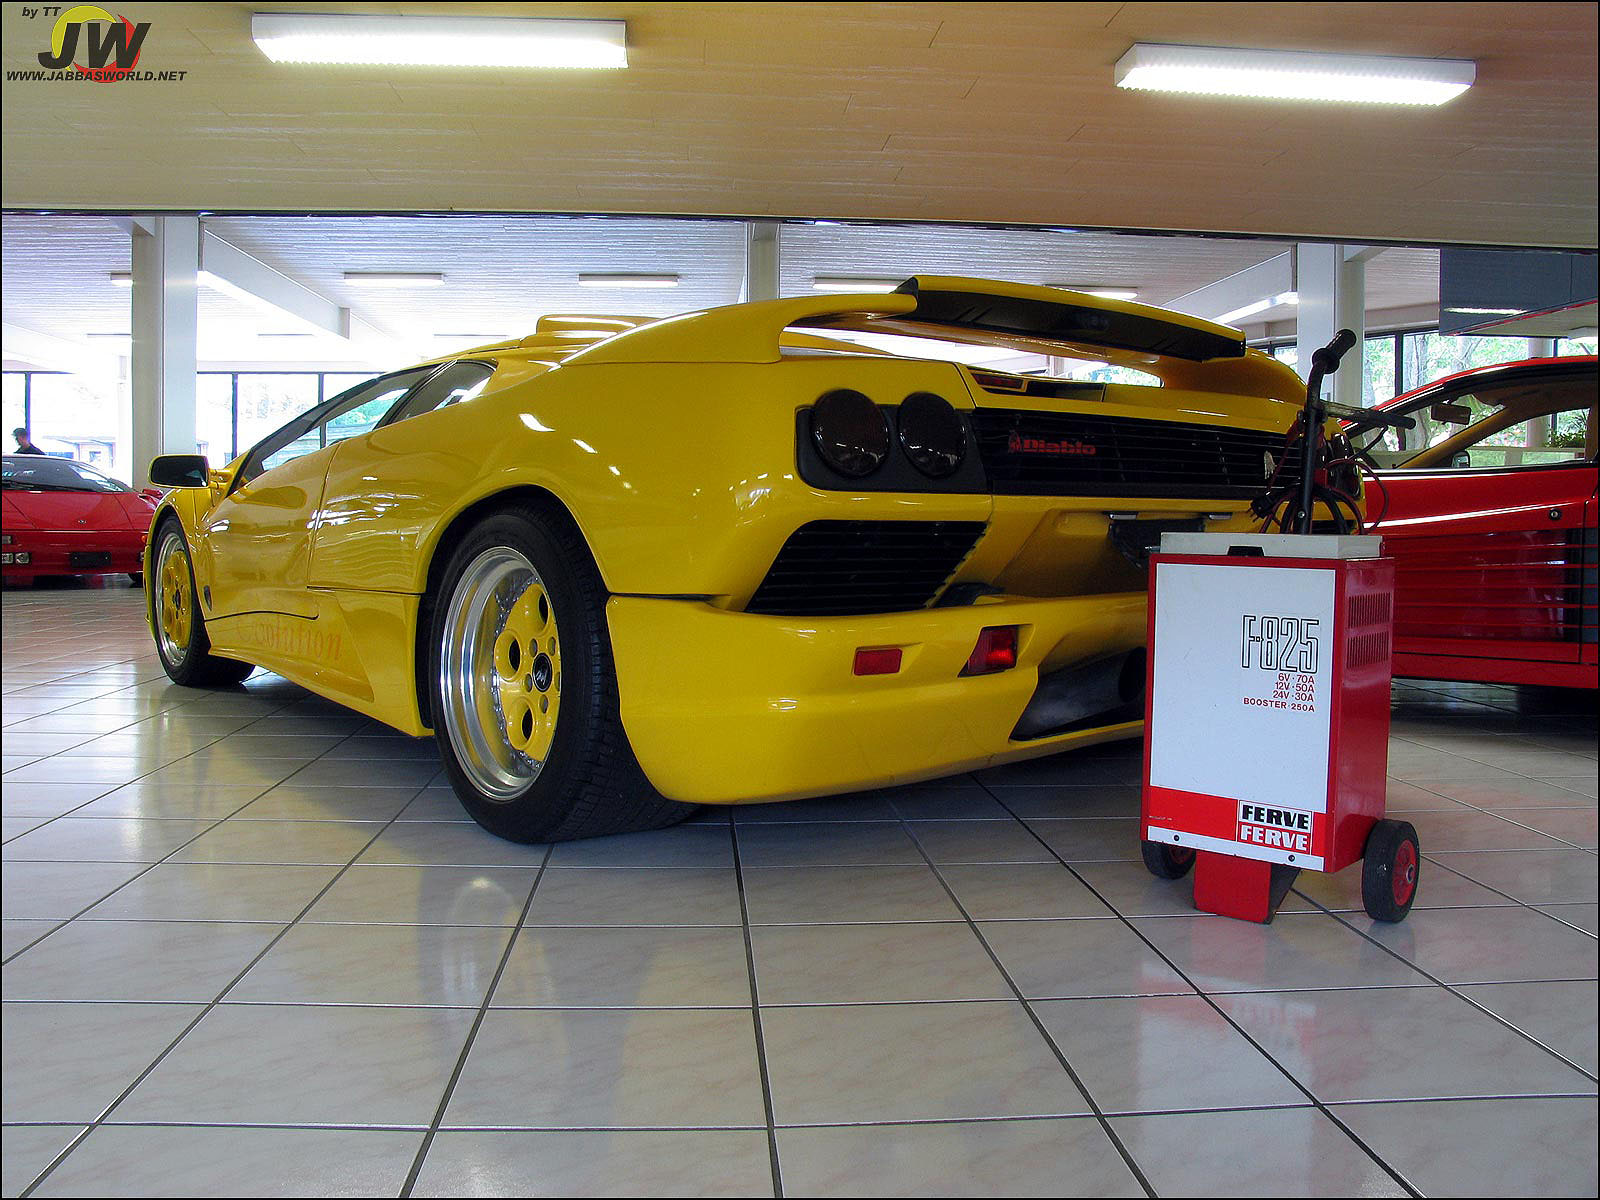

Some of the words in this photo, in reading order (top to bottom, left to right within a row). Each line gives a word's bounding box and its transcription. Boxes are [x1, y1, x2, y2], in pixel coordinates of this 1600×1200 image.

[1023, 439, 1096, 455] Diablo
[1242, 804, 1310, 830] FERVE
[1240, 824, 1309, 851] FERVE
